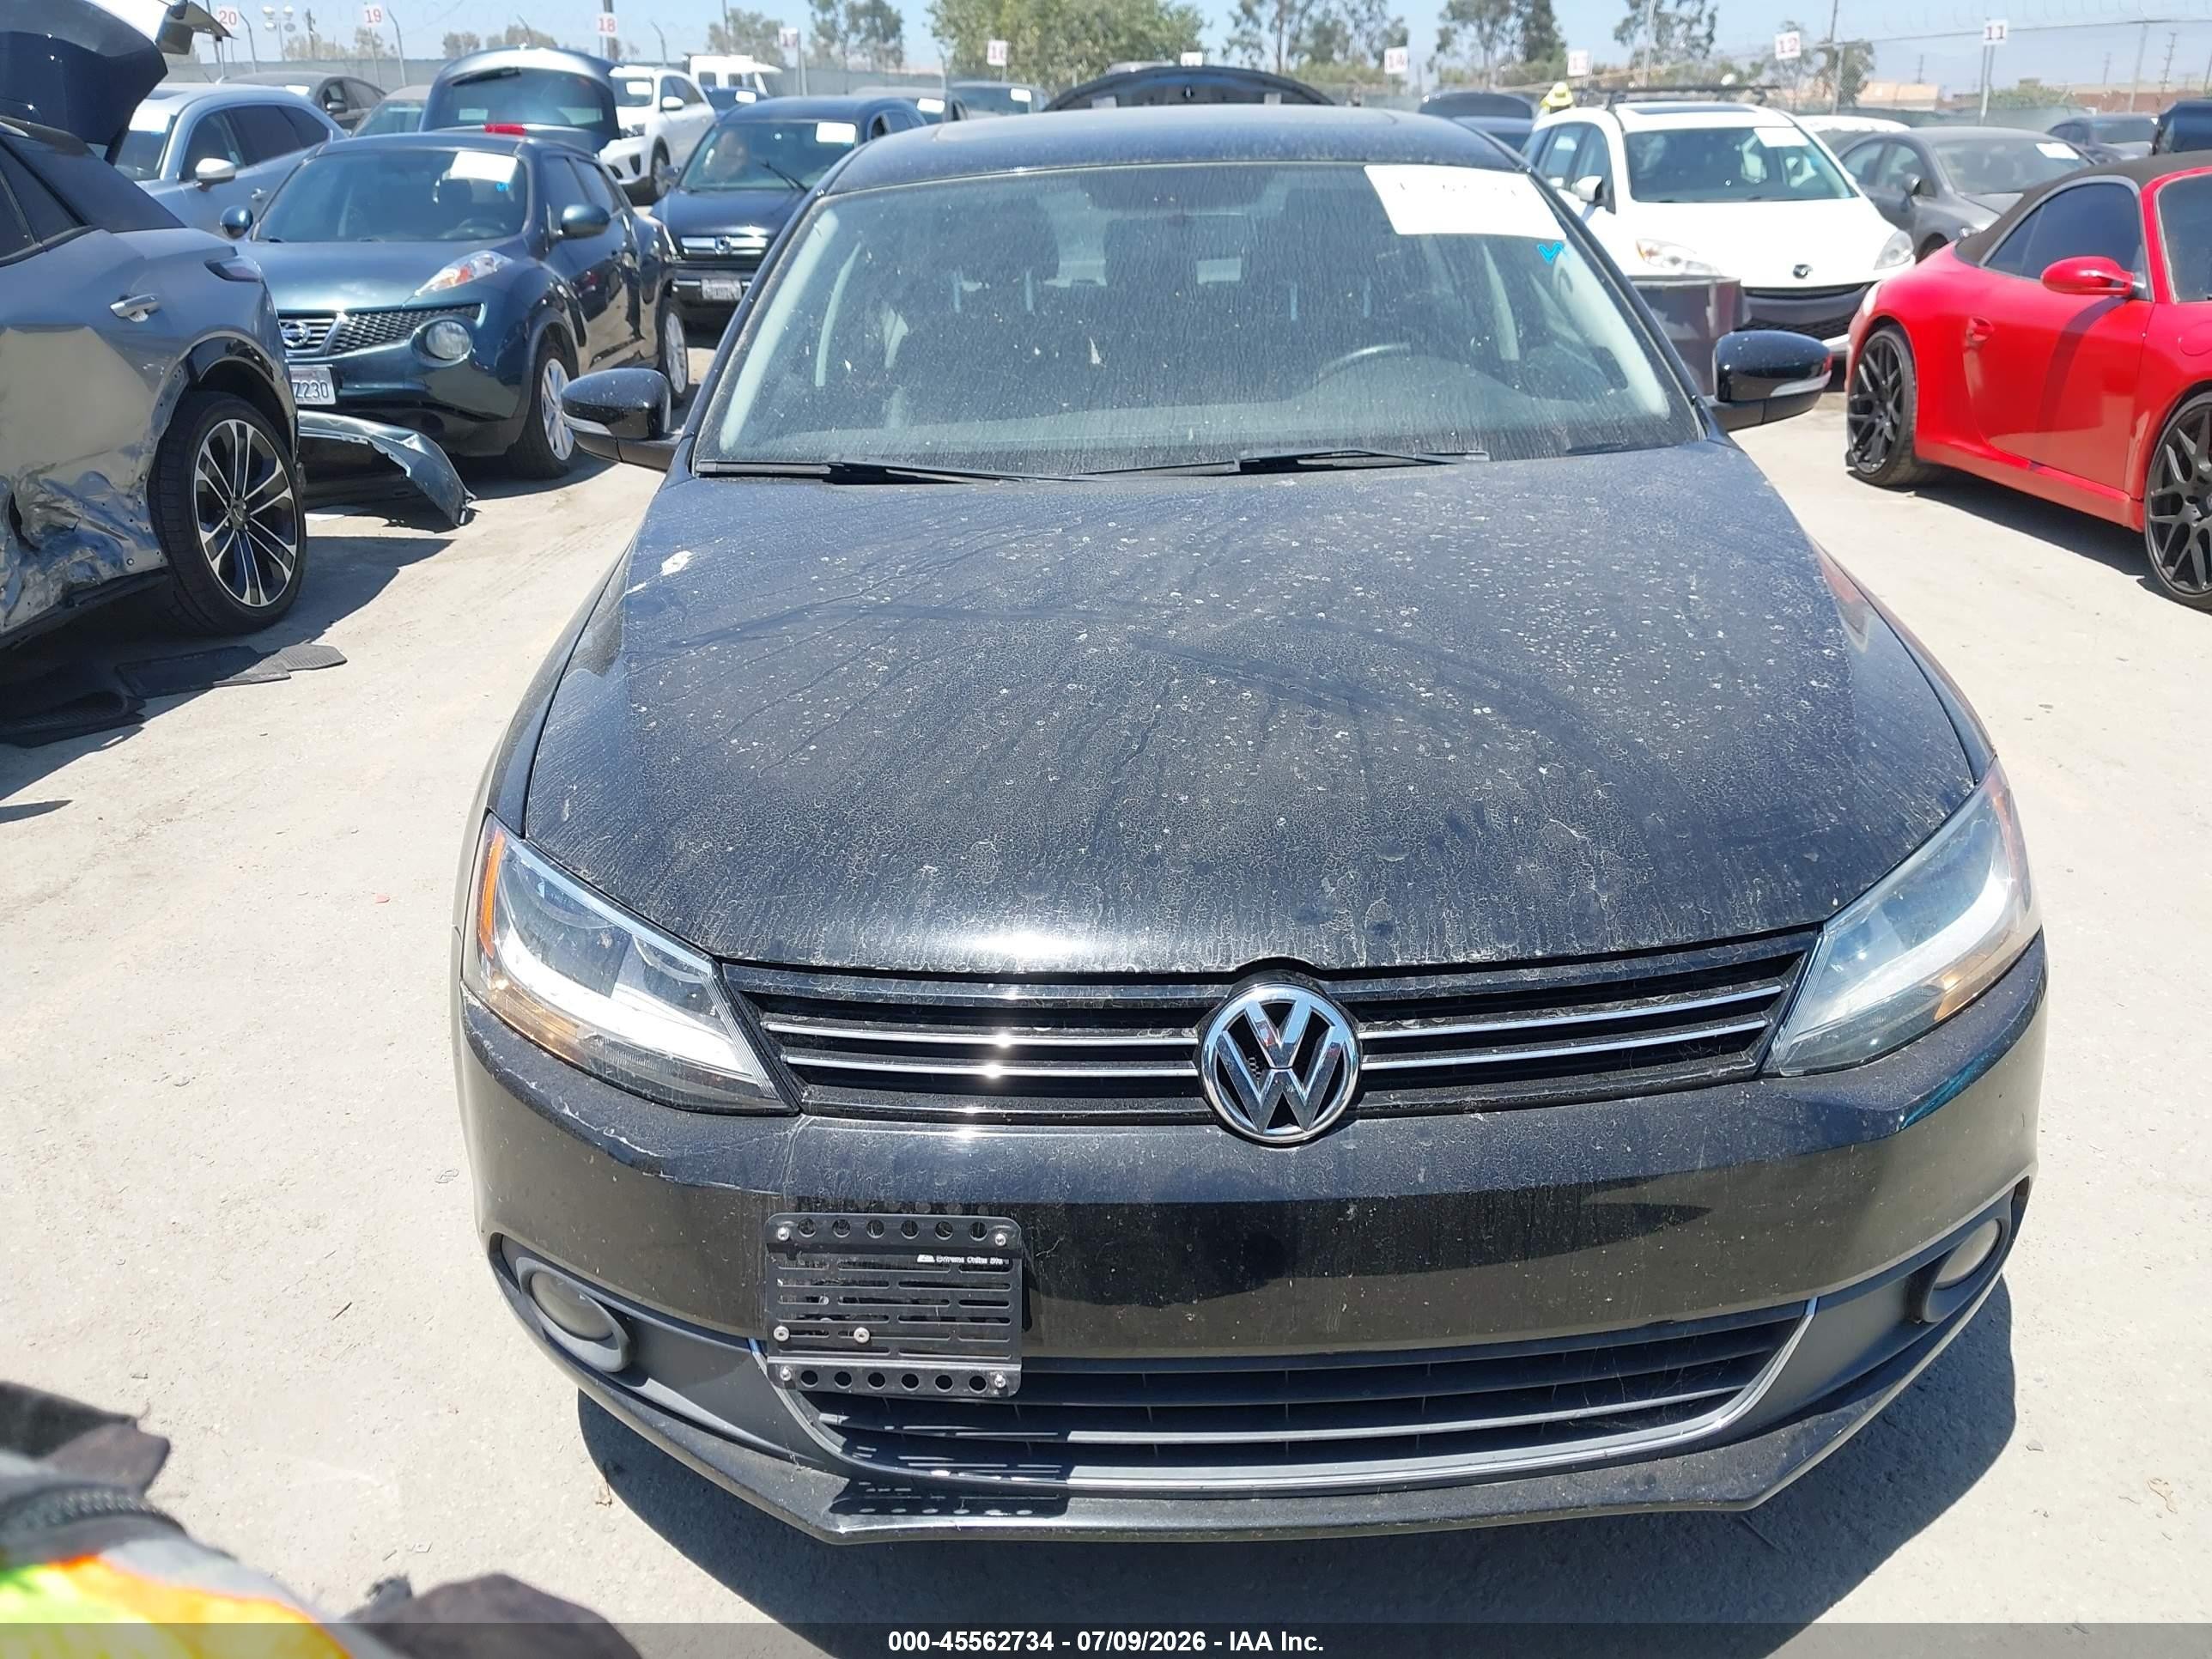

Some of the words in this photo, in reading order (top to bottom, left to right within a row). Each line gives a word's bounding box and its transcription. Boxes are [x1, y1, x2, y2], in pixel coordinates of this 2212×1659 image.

[219, 10, 237, 25] 20
[365, 9, 382, 23] 19
[599, 18, 616, 33] 18
[1984, 26, 2004, 40] 11
[1778, 37, 1798, 53] 12
[1211, 996, 1350, 1135] VW
